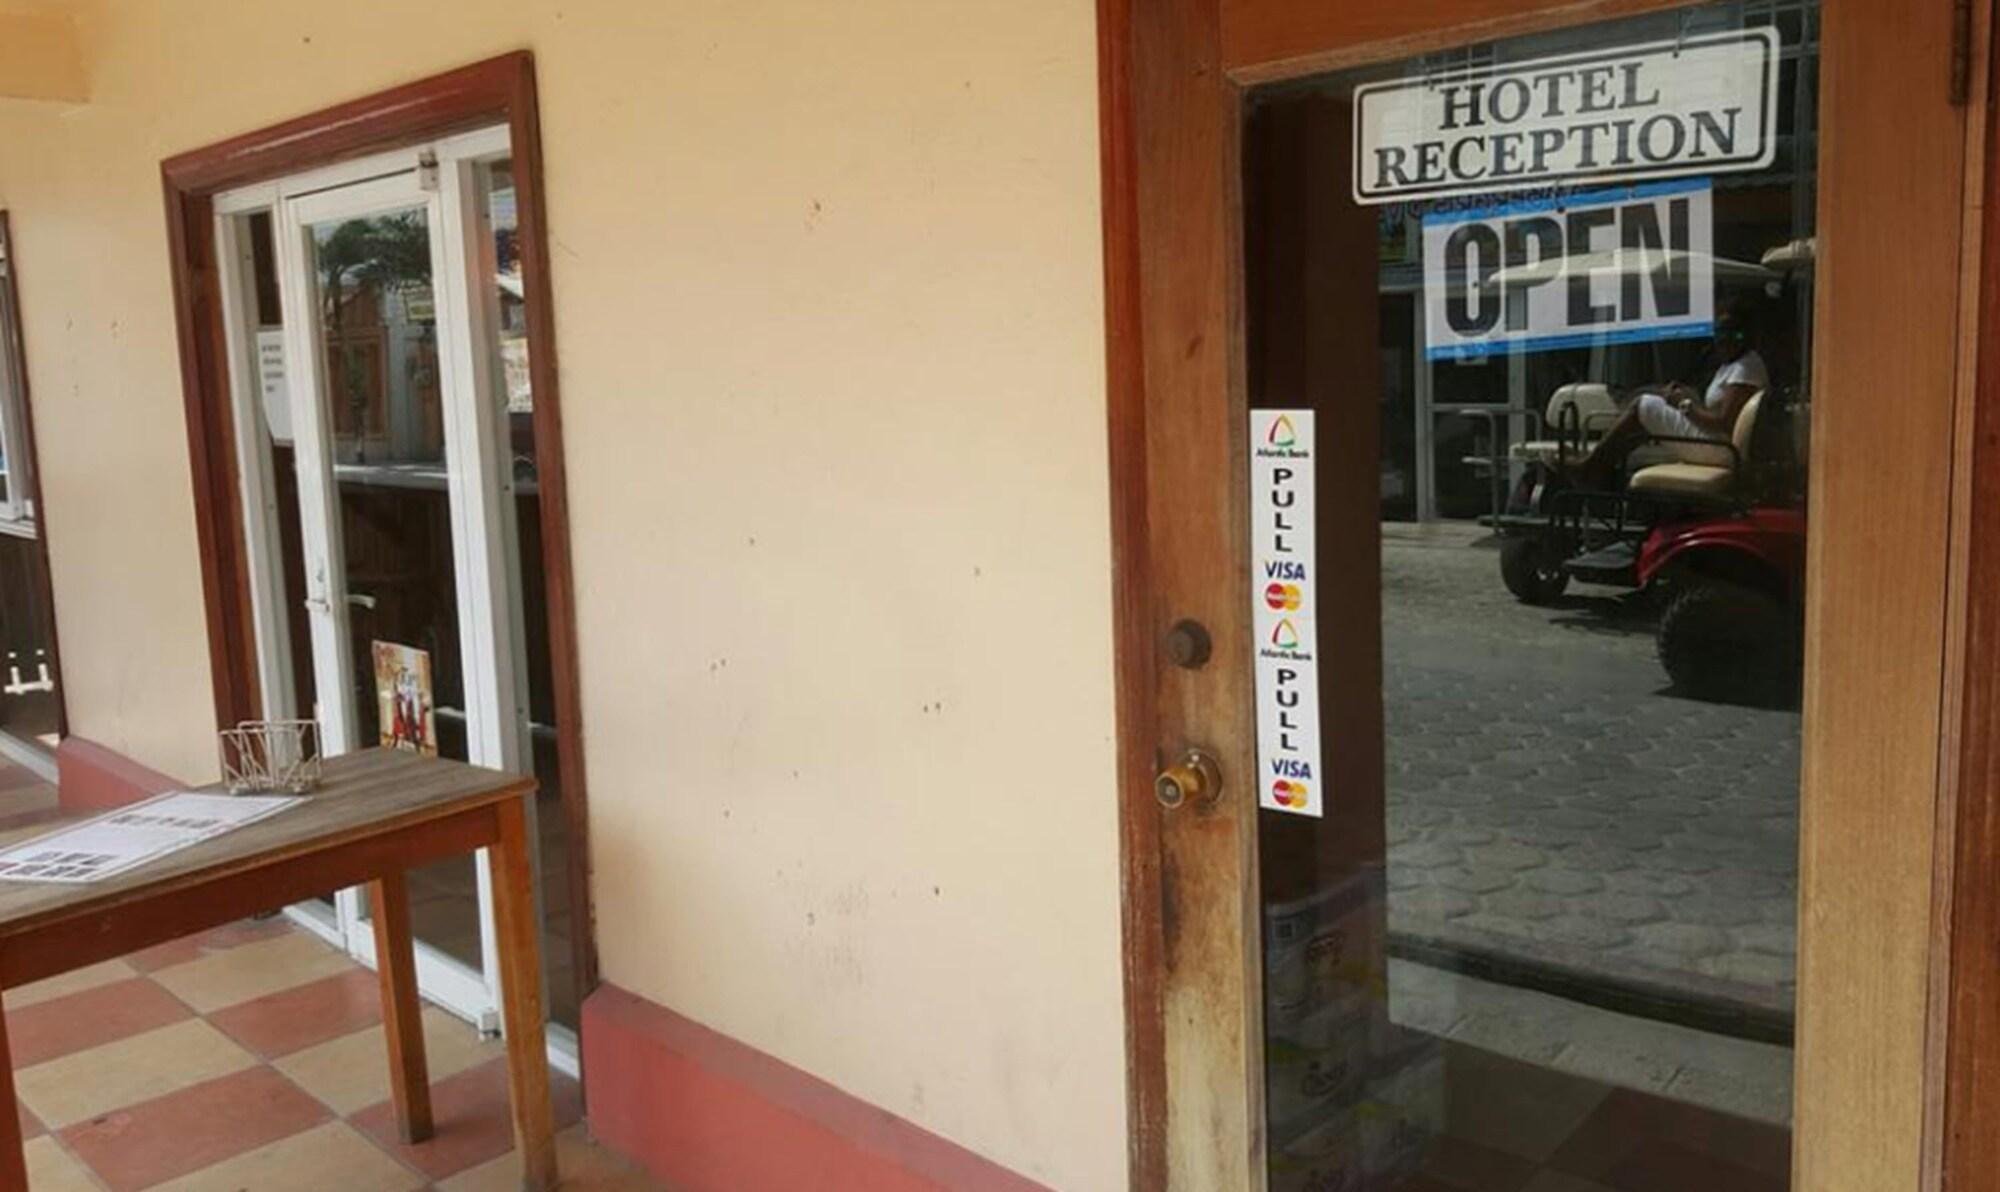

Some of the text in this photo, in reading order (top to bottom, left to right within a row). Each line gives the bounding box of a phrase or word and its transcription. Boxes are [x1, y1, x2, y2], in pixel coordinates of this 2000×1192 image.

[1438, 62, 1660, 131] HOTEL
[1373, 107, 1742, 189] RECEPTION
[1443, 198, 1691, 337] OPEN
[1271, 468, 1295, 553] PULL
[1265, 561, 1306, 581] VISA
[1276, 668, 1299, 751] PULL
[1271, 759, 1312, 780] VISA
